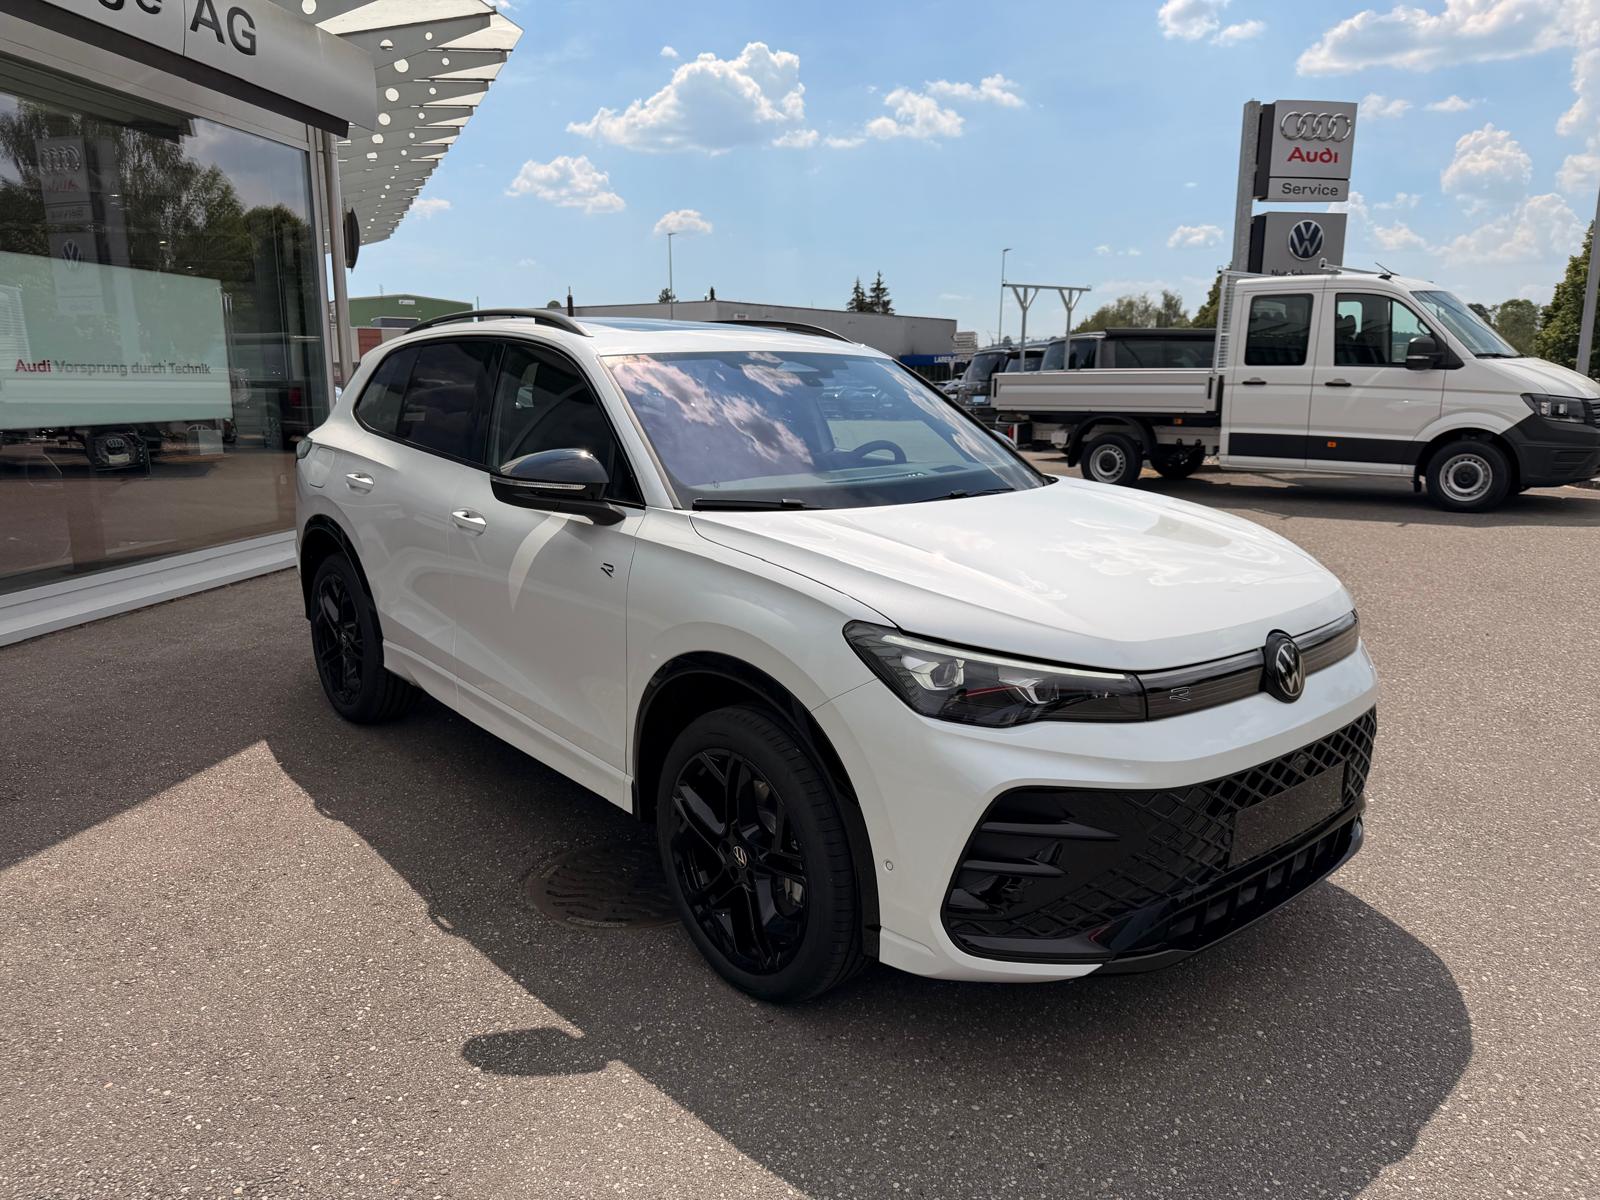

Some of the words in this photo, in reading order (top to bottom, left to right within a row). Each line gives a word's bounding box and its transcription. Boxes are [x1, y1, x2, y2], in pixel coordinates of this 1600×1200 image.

[189, 0, 256, 56] AG
[1287, 147, 1339, 164] Audi
[1281, 183, 1339, 196] Service
[1288, 220, 1324, 260] VW
[15, 359, 51, 372] Audi
[55, 360, 128, 376] Vorsprung
[131, 362, 166, 374] durch
[169, 362, 212, 375] Technik
